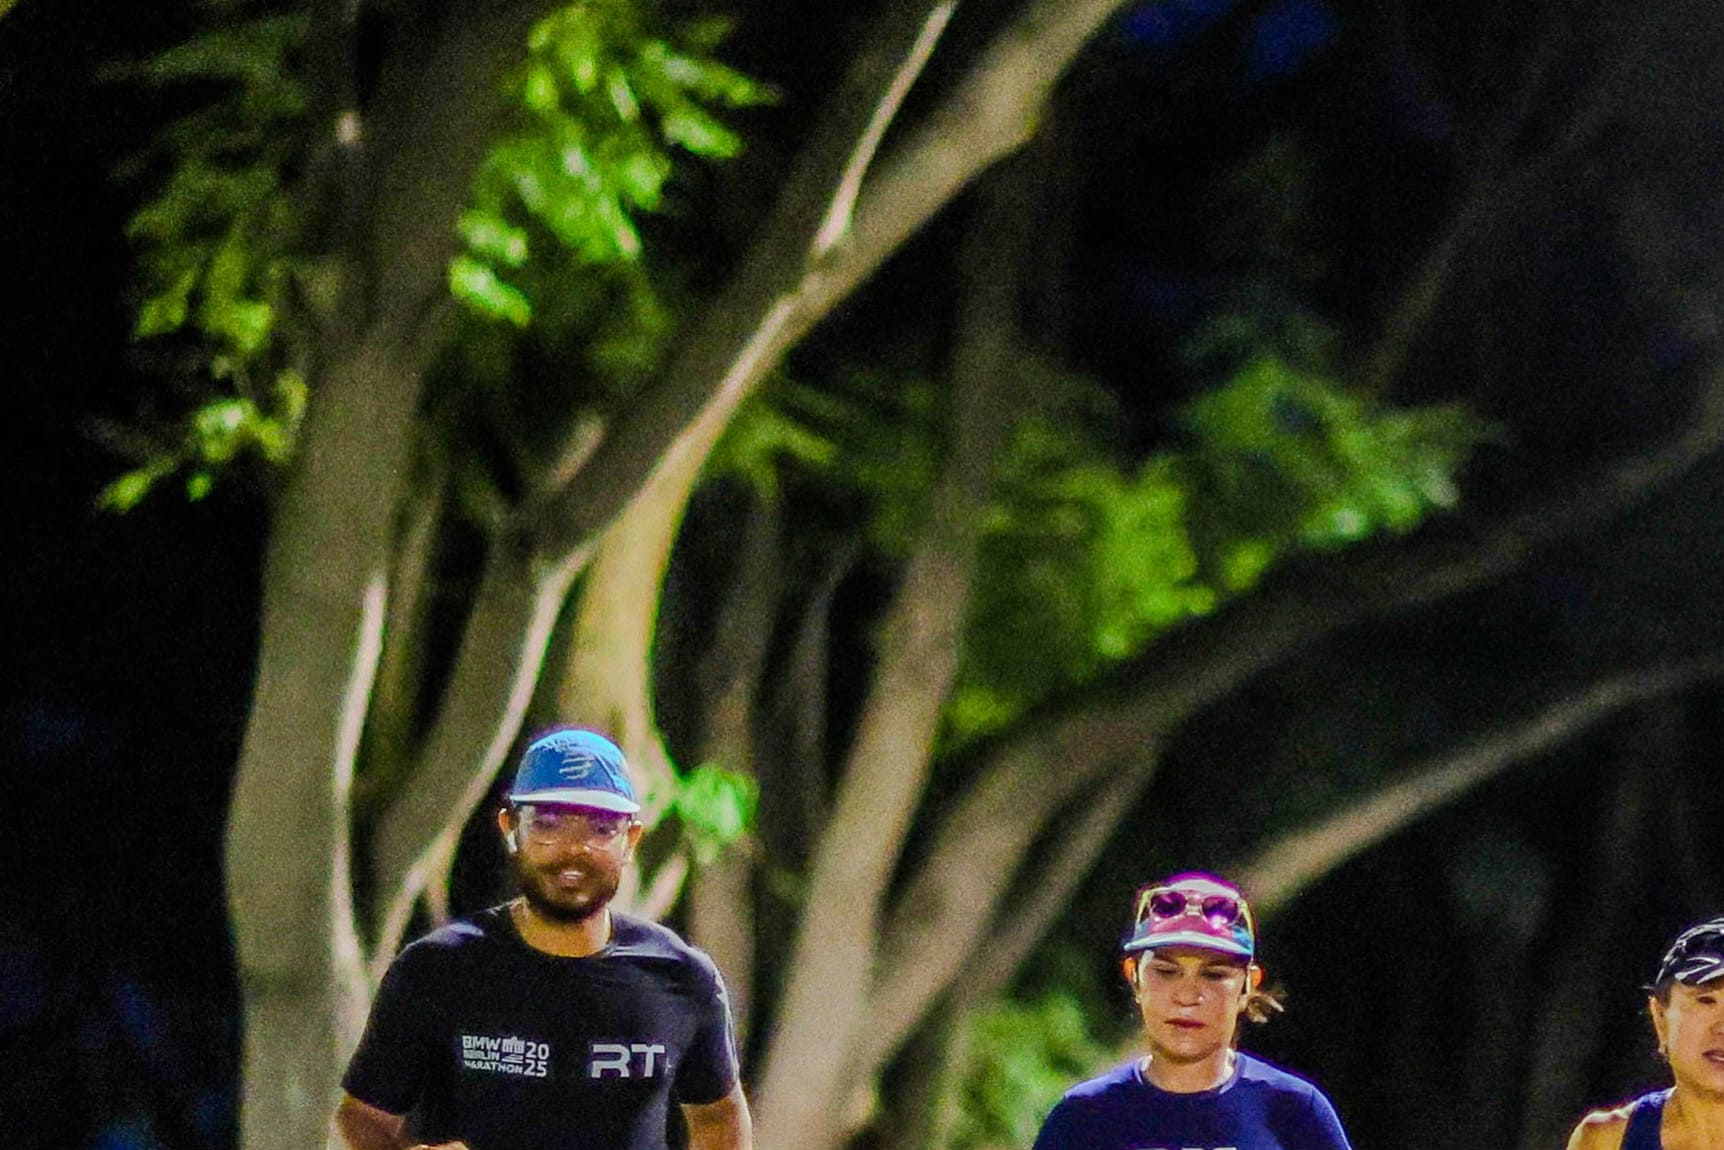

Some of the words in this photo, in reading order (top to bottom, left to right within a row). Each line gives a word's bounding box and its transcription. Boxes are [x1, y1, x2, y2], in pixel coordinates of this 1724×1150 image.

[462, 1035, 501, 1051] BMW
[525, 1041, 550, 1060] 20
[523, 1058, 548, 1077] 25
[591, 1043, 666, 1078] RT
